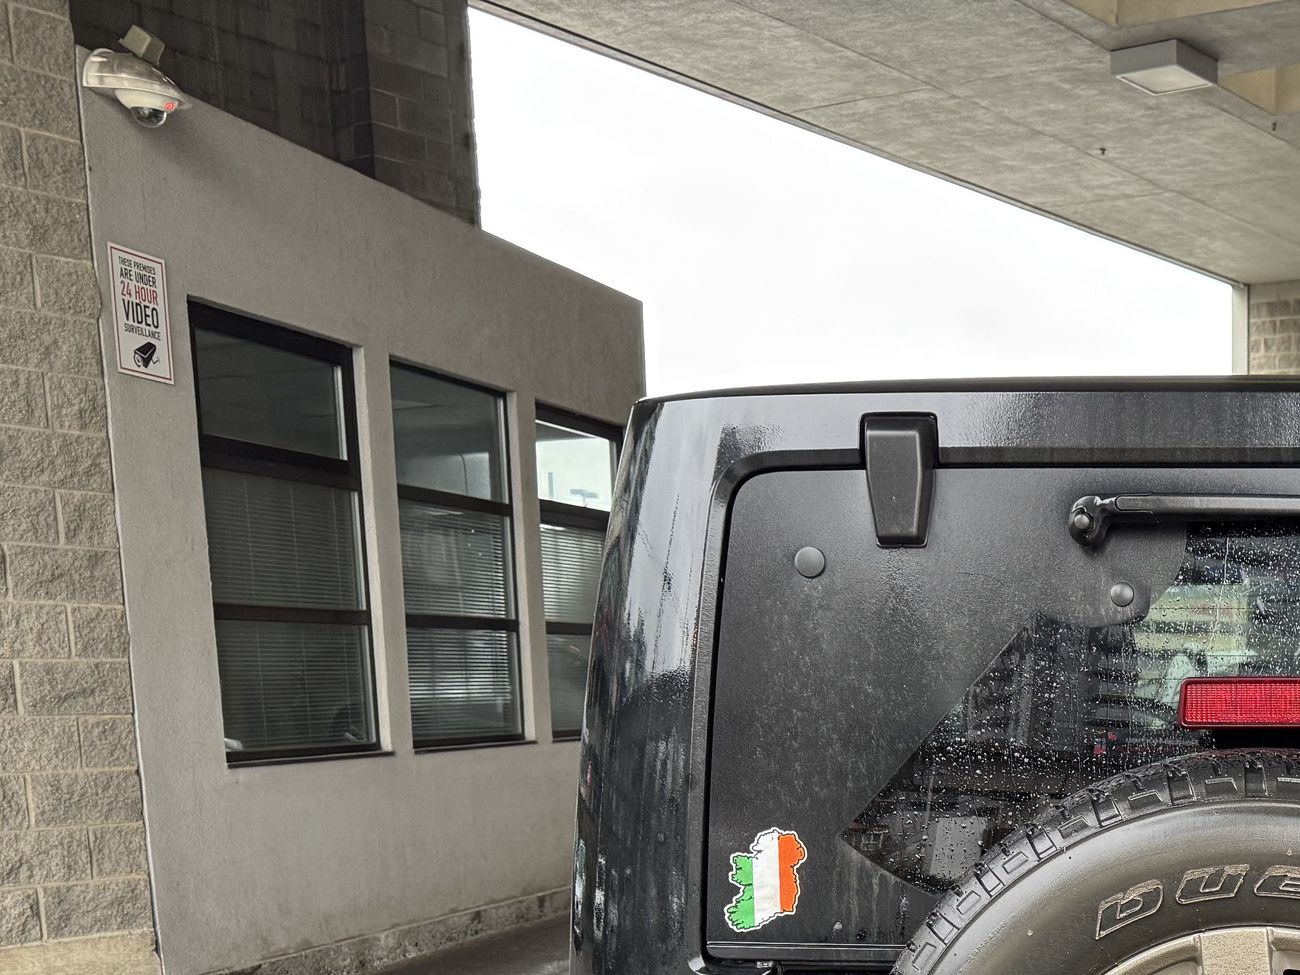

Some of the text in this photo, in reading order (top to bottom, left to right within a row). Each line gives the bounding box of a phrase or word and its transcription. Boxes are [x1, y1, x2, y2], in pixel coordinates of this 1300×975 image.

[118, 256, 156, 276] THESE PREMISES
[120, 267, 157, 289] ARE UNDER
[120, 280, 158, 305] 24 HOUR
[122, 298, 159, 329] VIDEO
[124, 322, 161, 340] SURVEILLANCE
